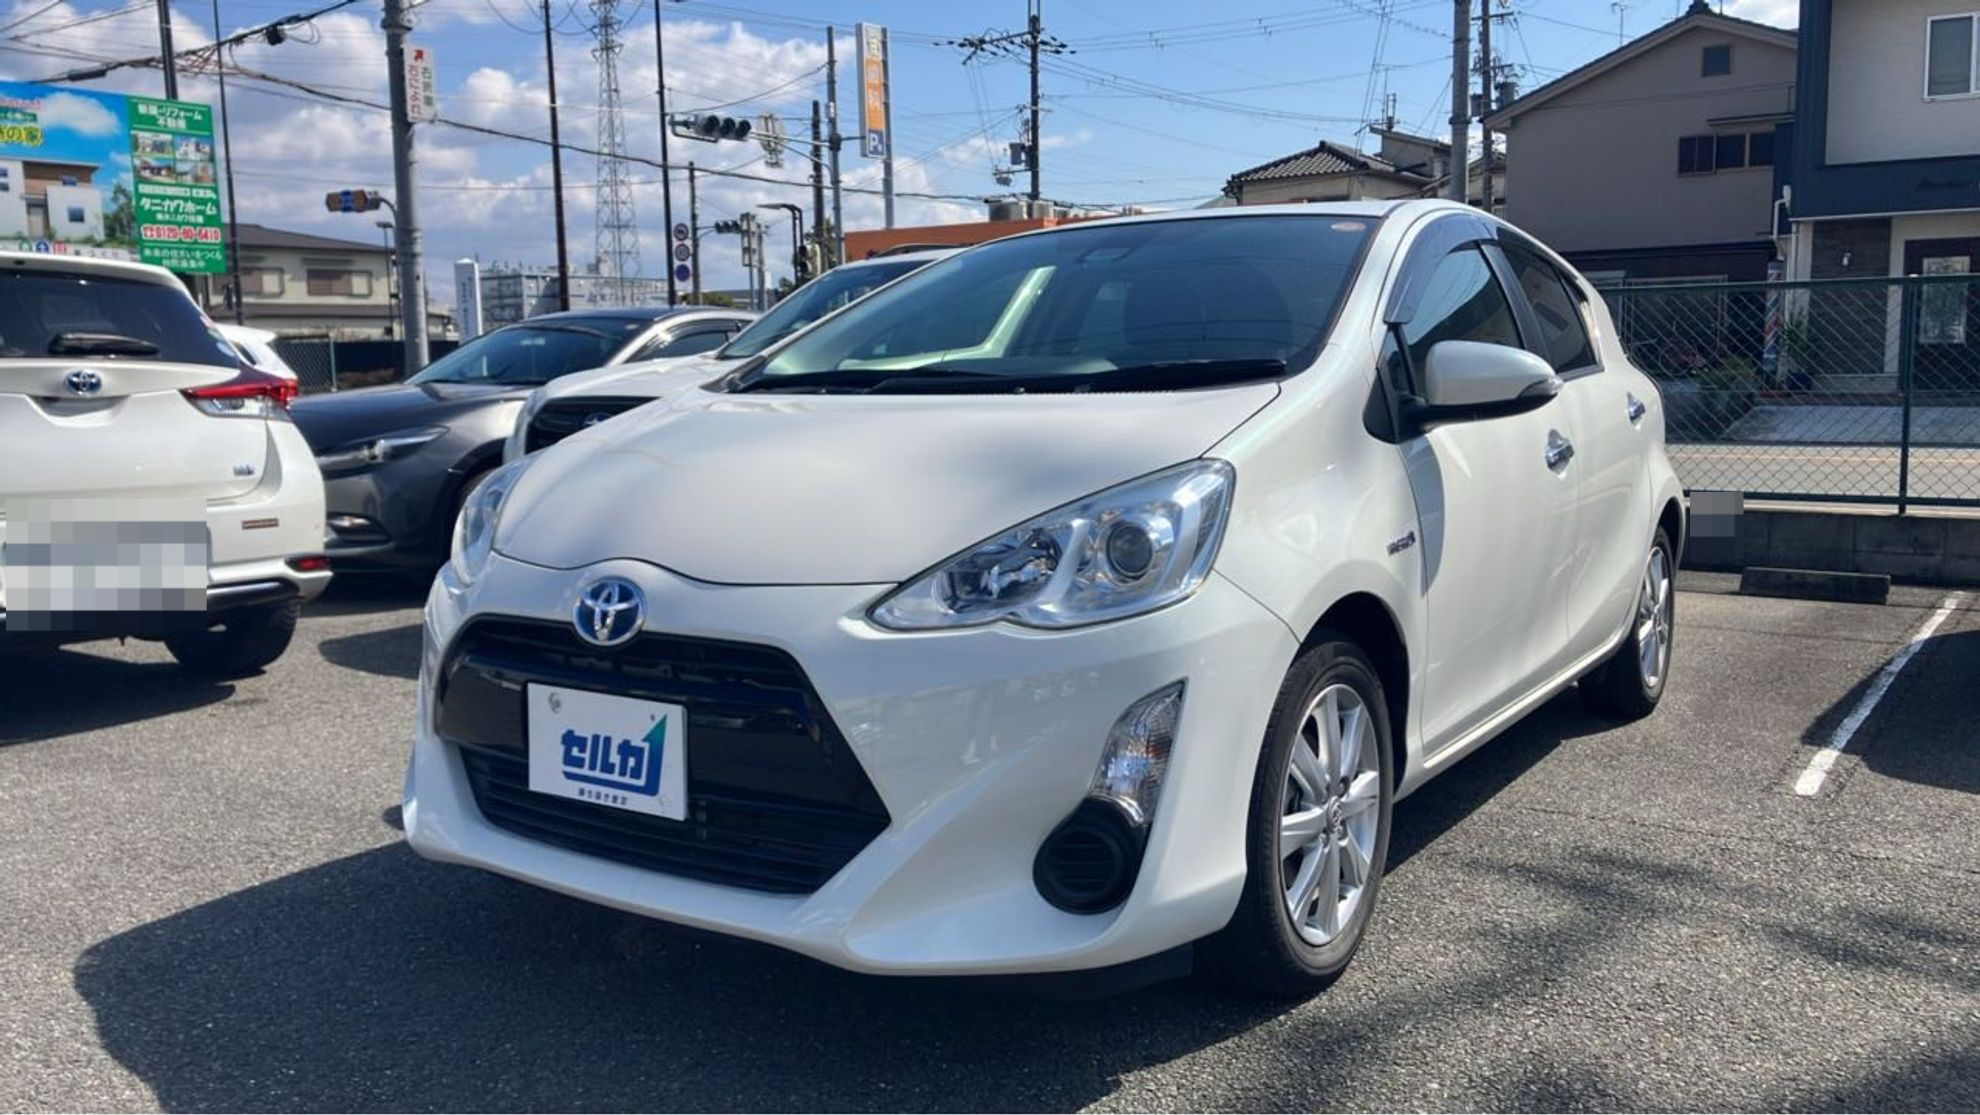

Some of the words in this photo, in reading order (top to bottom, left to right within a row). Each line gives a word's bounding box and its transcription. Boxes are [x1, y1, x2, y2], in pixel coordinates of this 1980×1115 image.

[140, 197, 217, 215] タニカワホーム
[561, 729, 645, 780] セルカ
